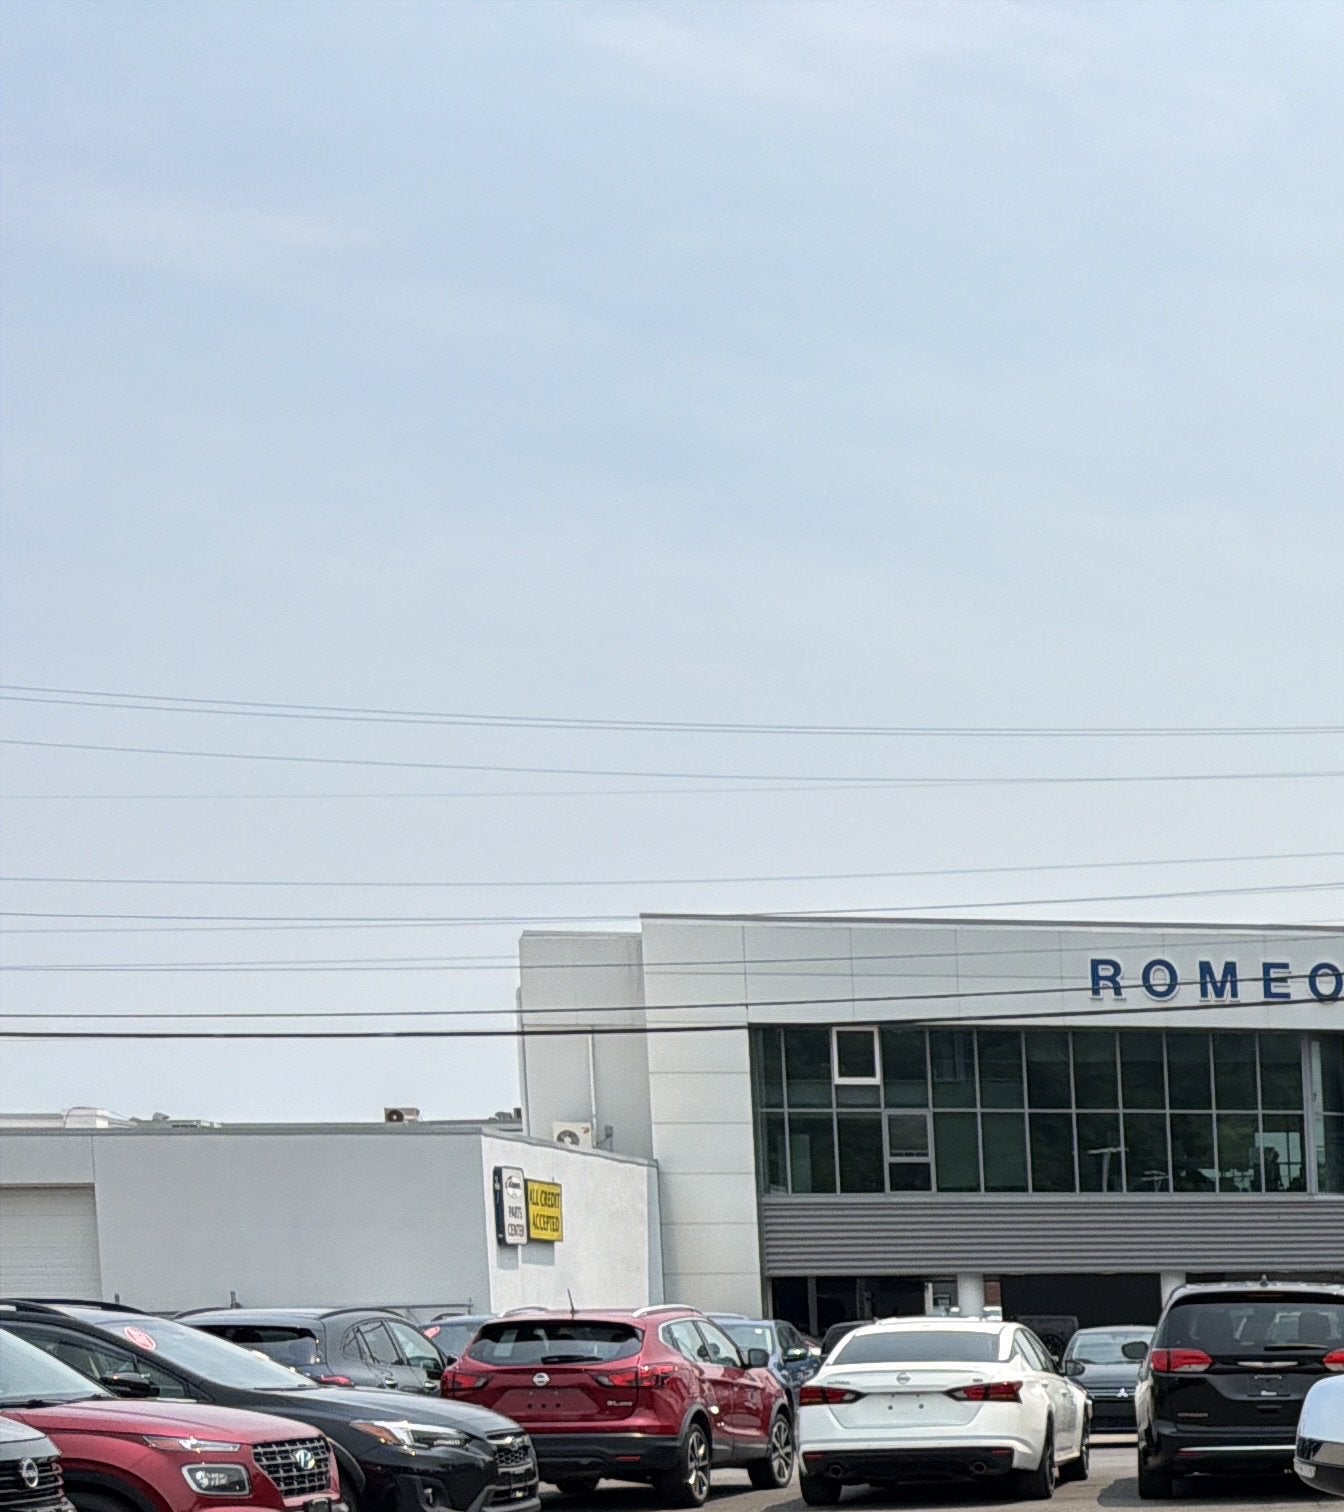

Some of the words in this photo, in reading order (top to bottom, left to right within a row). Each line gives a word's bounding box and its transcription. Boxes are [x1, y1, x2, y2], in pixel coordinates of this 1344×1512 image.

[1089, 957, 1344, 1001] ROMEO
[540, 1189, 561, 1209] CREDIT
[507, 1223, 525, 1237] CENTER
[532, 1213, 560, 1233] ACCEPTED
